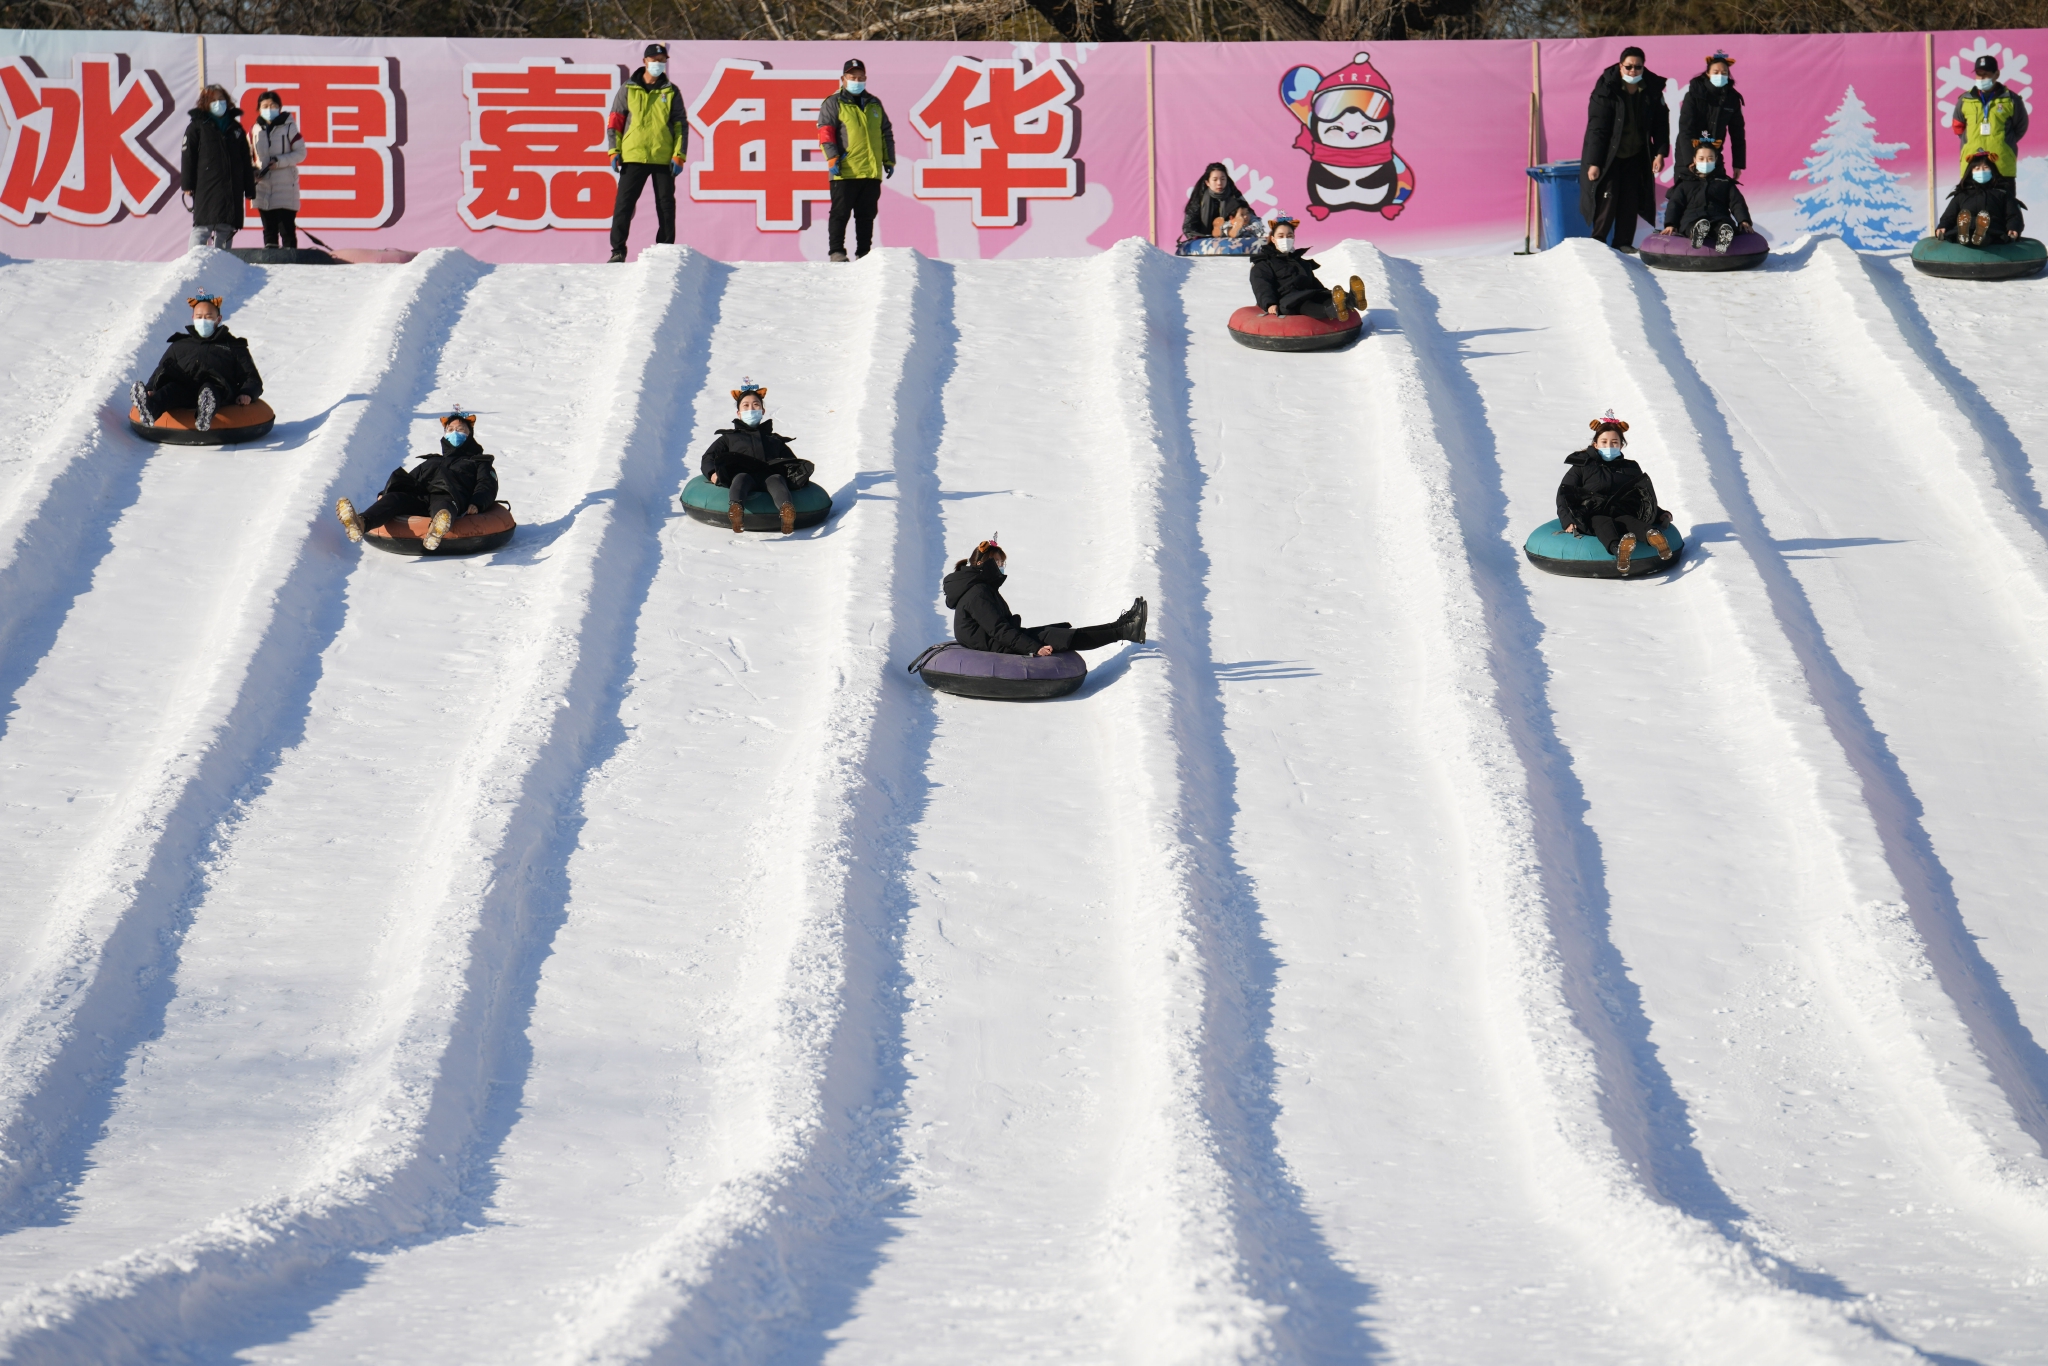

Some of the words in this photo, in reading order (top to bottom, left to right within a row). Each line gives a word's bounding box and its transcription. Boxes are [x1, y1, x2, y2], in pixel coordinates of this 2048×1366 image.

[0, 56, 1076, 225] 冰雪嘉年华
